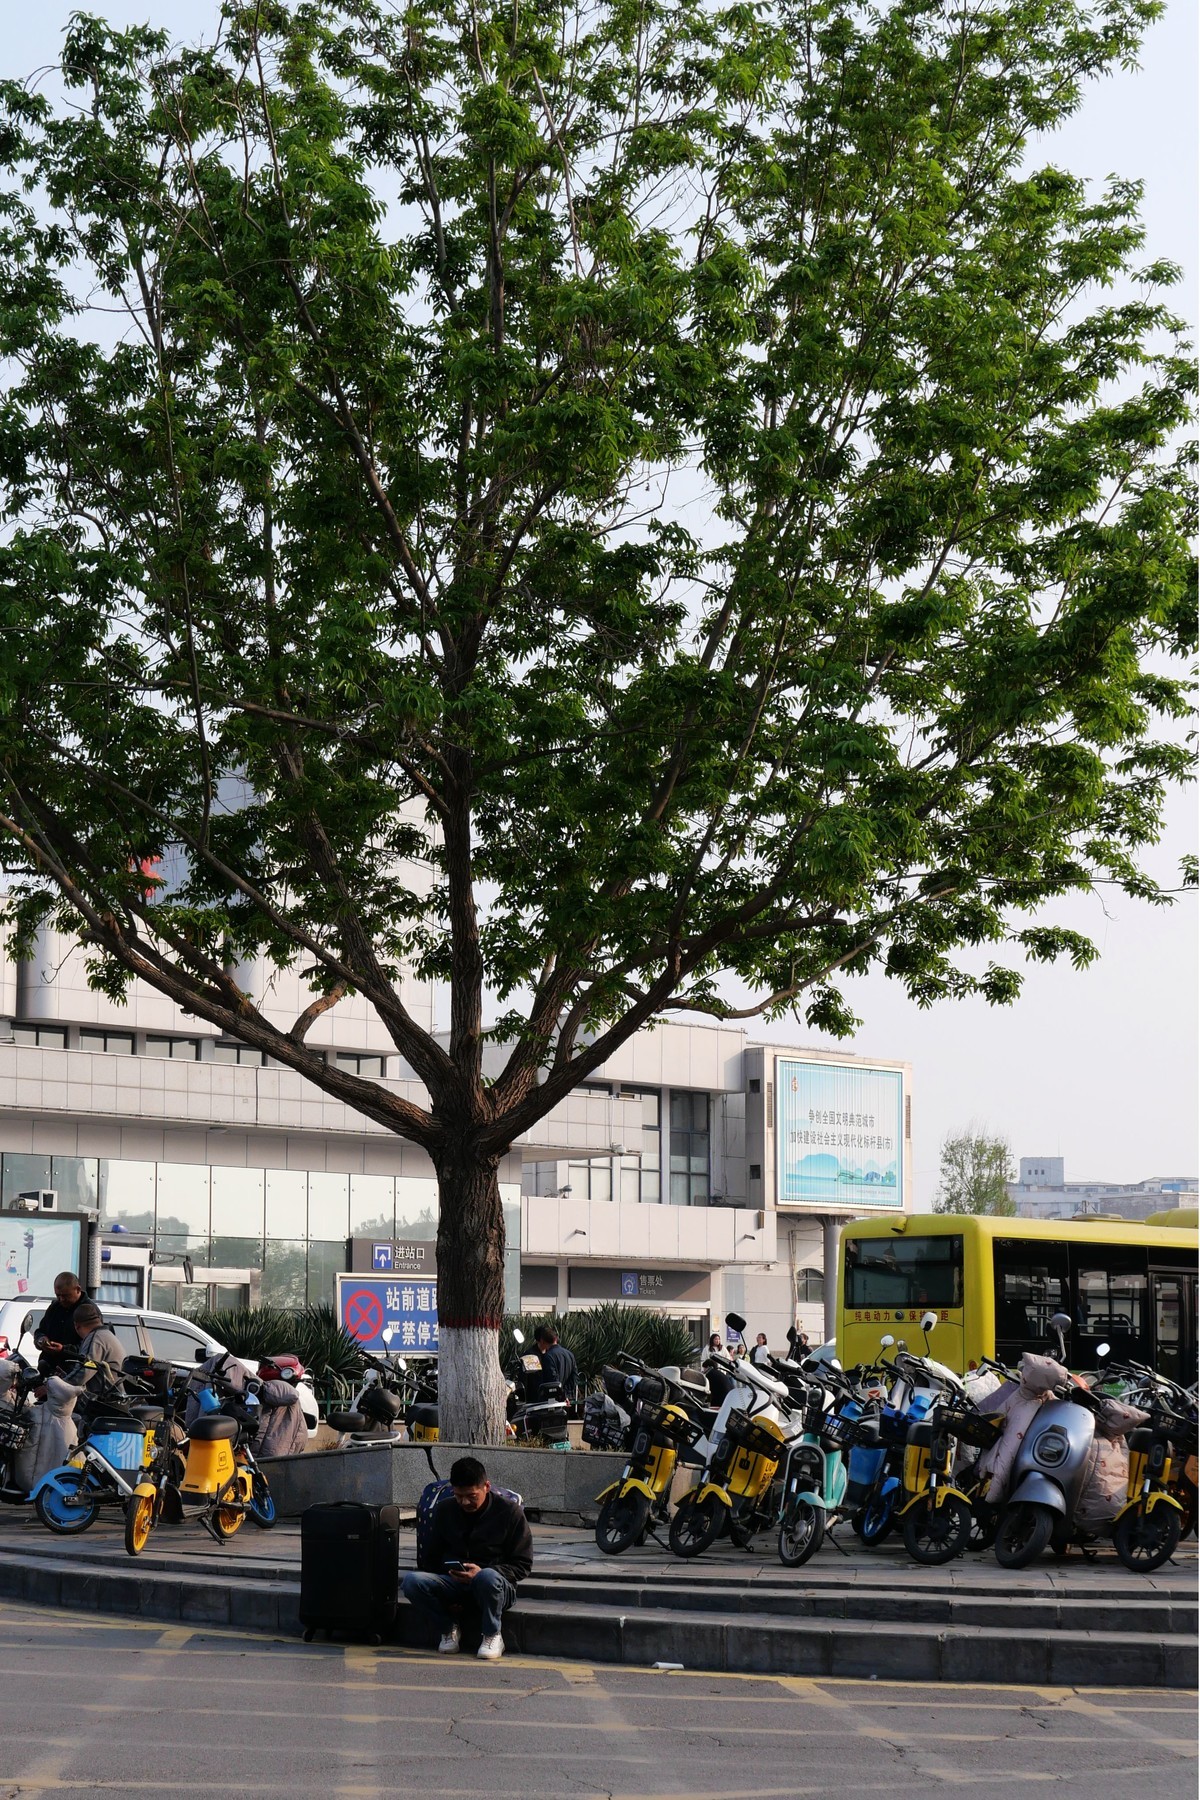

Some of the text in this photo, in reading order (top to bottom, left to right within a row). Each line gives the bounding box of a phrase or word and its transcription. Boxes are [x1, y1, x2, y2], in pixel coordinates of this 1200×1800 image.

[808, 1108, 875, 1128] 争创全国文明典范城市
[394, 1245, 425, 1260] 进站口
[394, 1261, 421, 1270] Entrance
[639, 1274, 663, 1287] 售票处
[639, 1287, 656, 1295] Tickets
[855, 1310, 949, 1321] 纯电动力 保距
